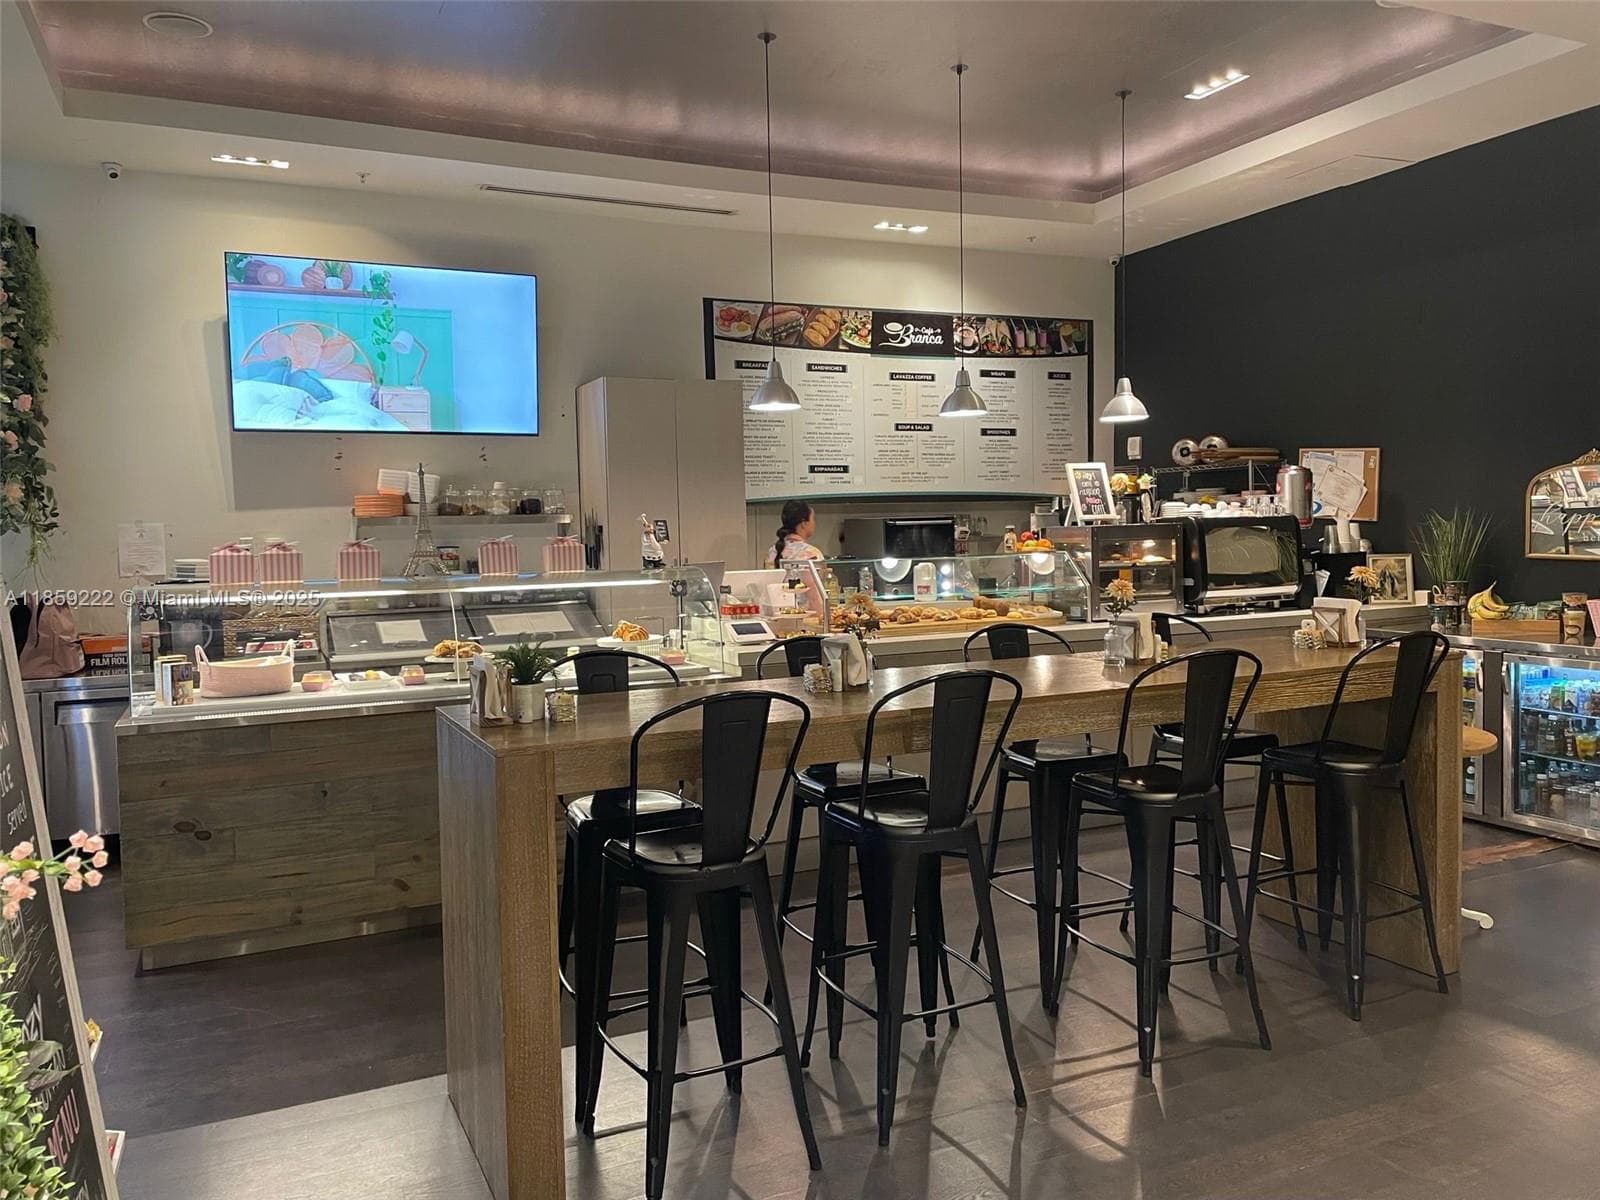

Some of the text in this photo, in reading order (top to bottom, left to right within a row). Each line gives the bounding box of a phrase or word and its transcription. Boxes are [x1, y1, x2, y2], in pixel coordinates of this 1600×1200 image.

[880, 323, 944, 347] Branca
[1540, 502, 1600, 536] happ
[90, 658, 110, 666] FILM
[48, 1088, 80, 1167] MENU
